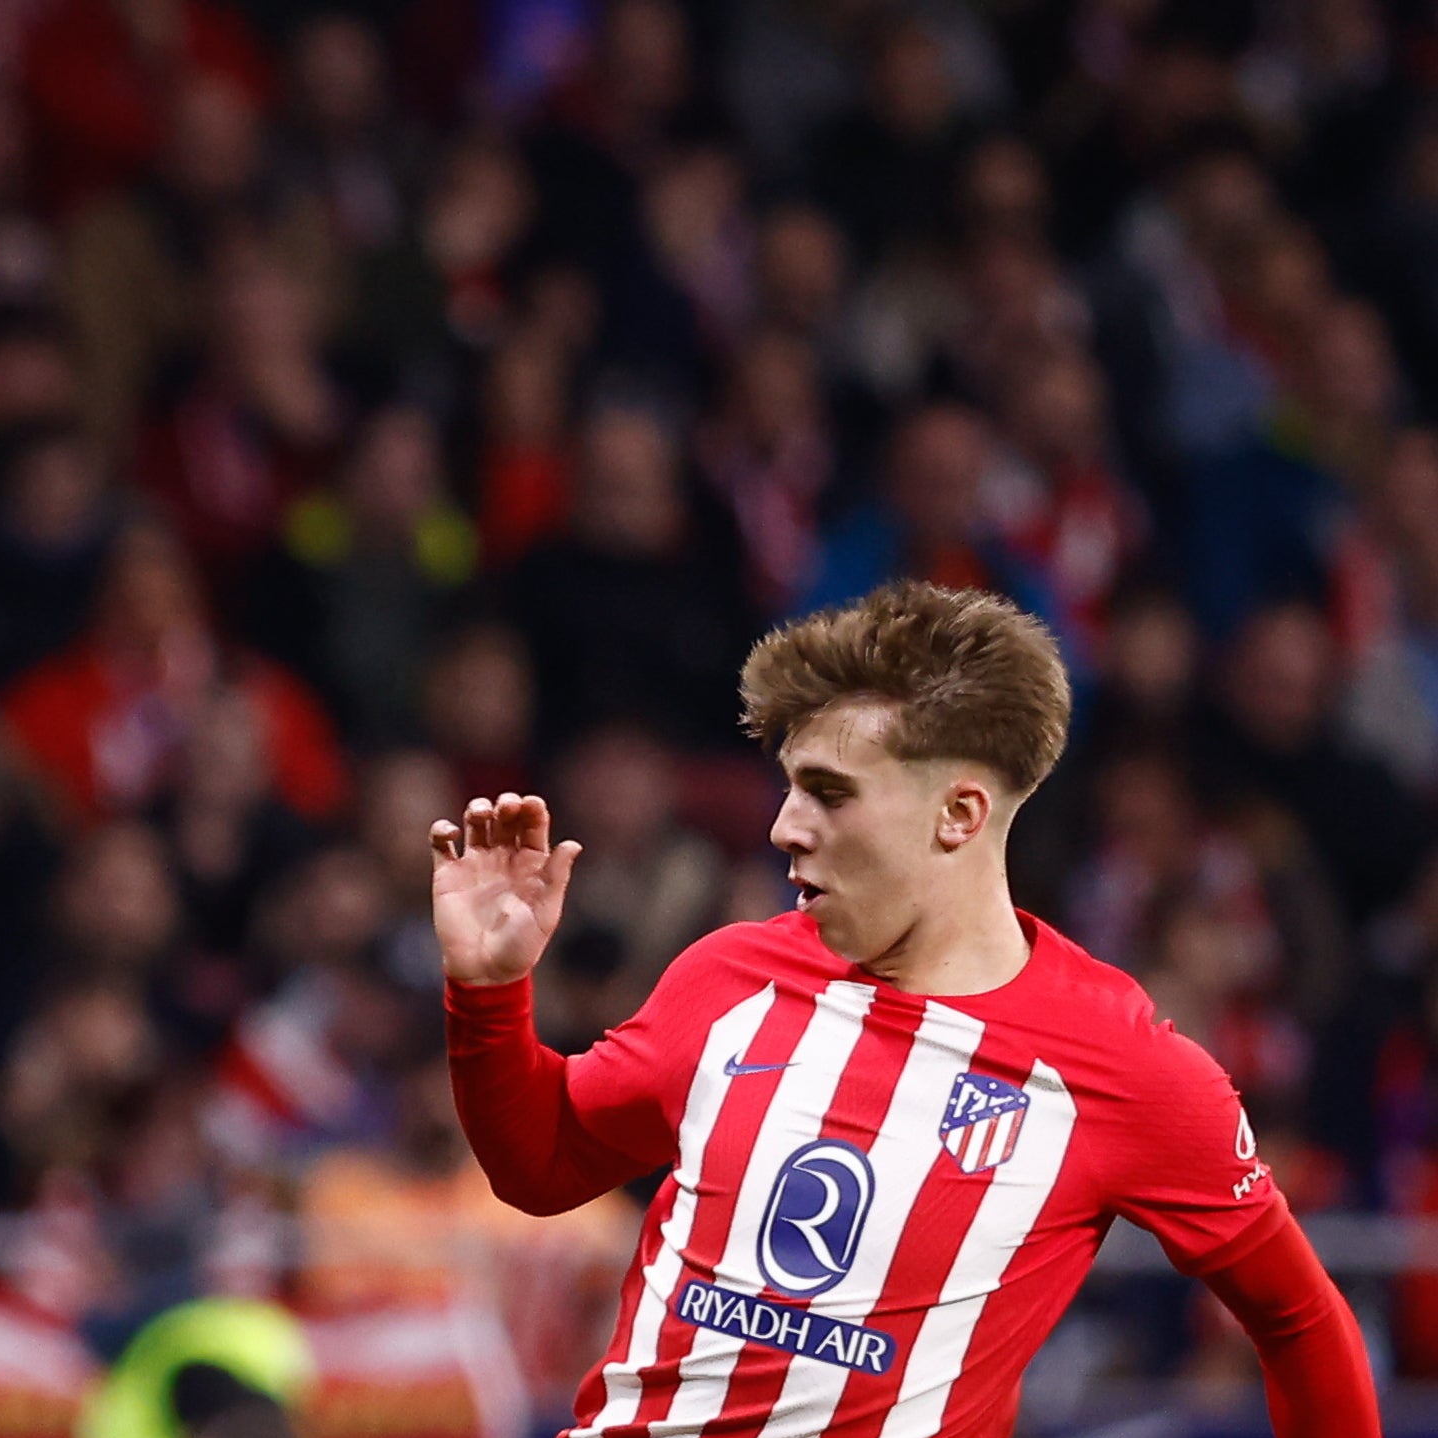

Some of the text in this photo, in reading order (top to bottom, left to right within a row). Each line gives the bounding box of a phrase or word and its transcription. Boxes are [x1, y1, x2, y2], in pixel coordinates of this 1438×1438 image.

[1233, 1164, 1267, 1200] HY
[680, 1284, 887, 1372] RIYADH AIR
